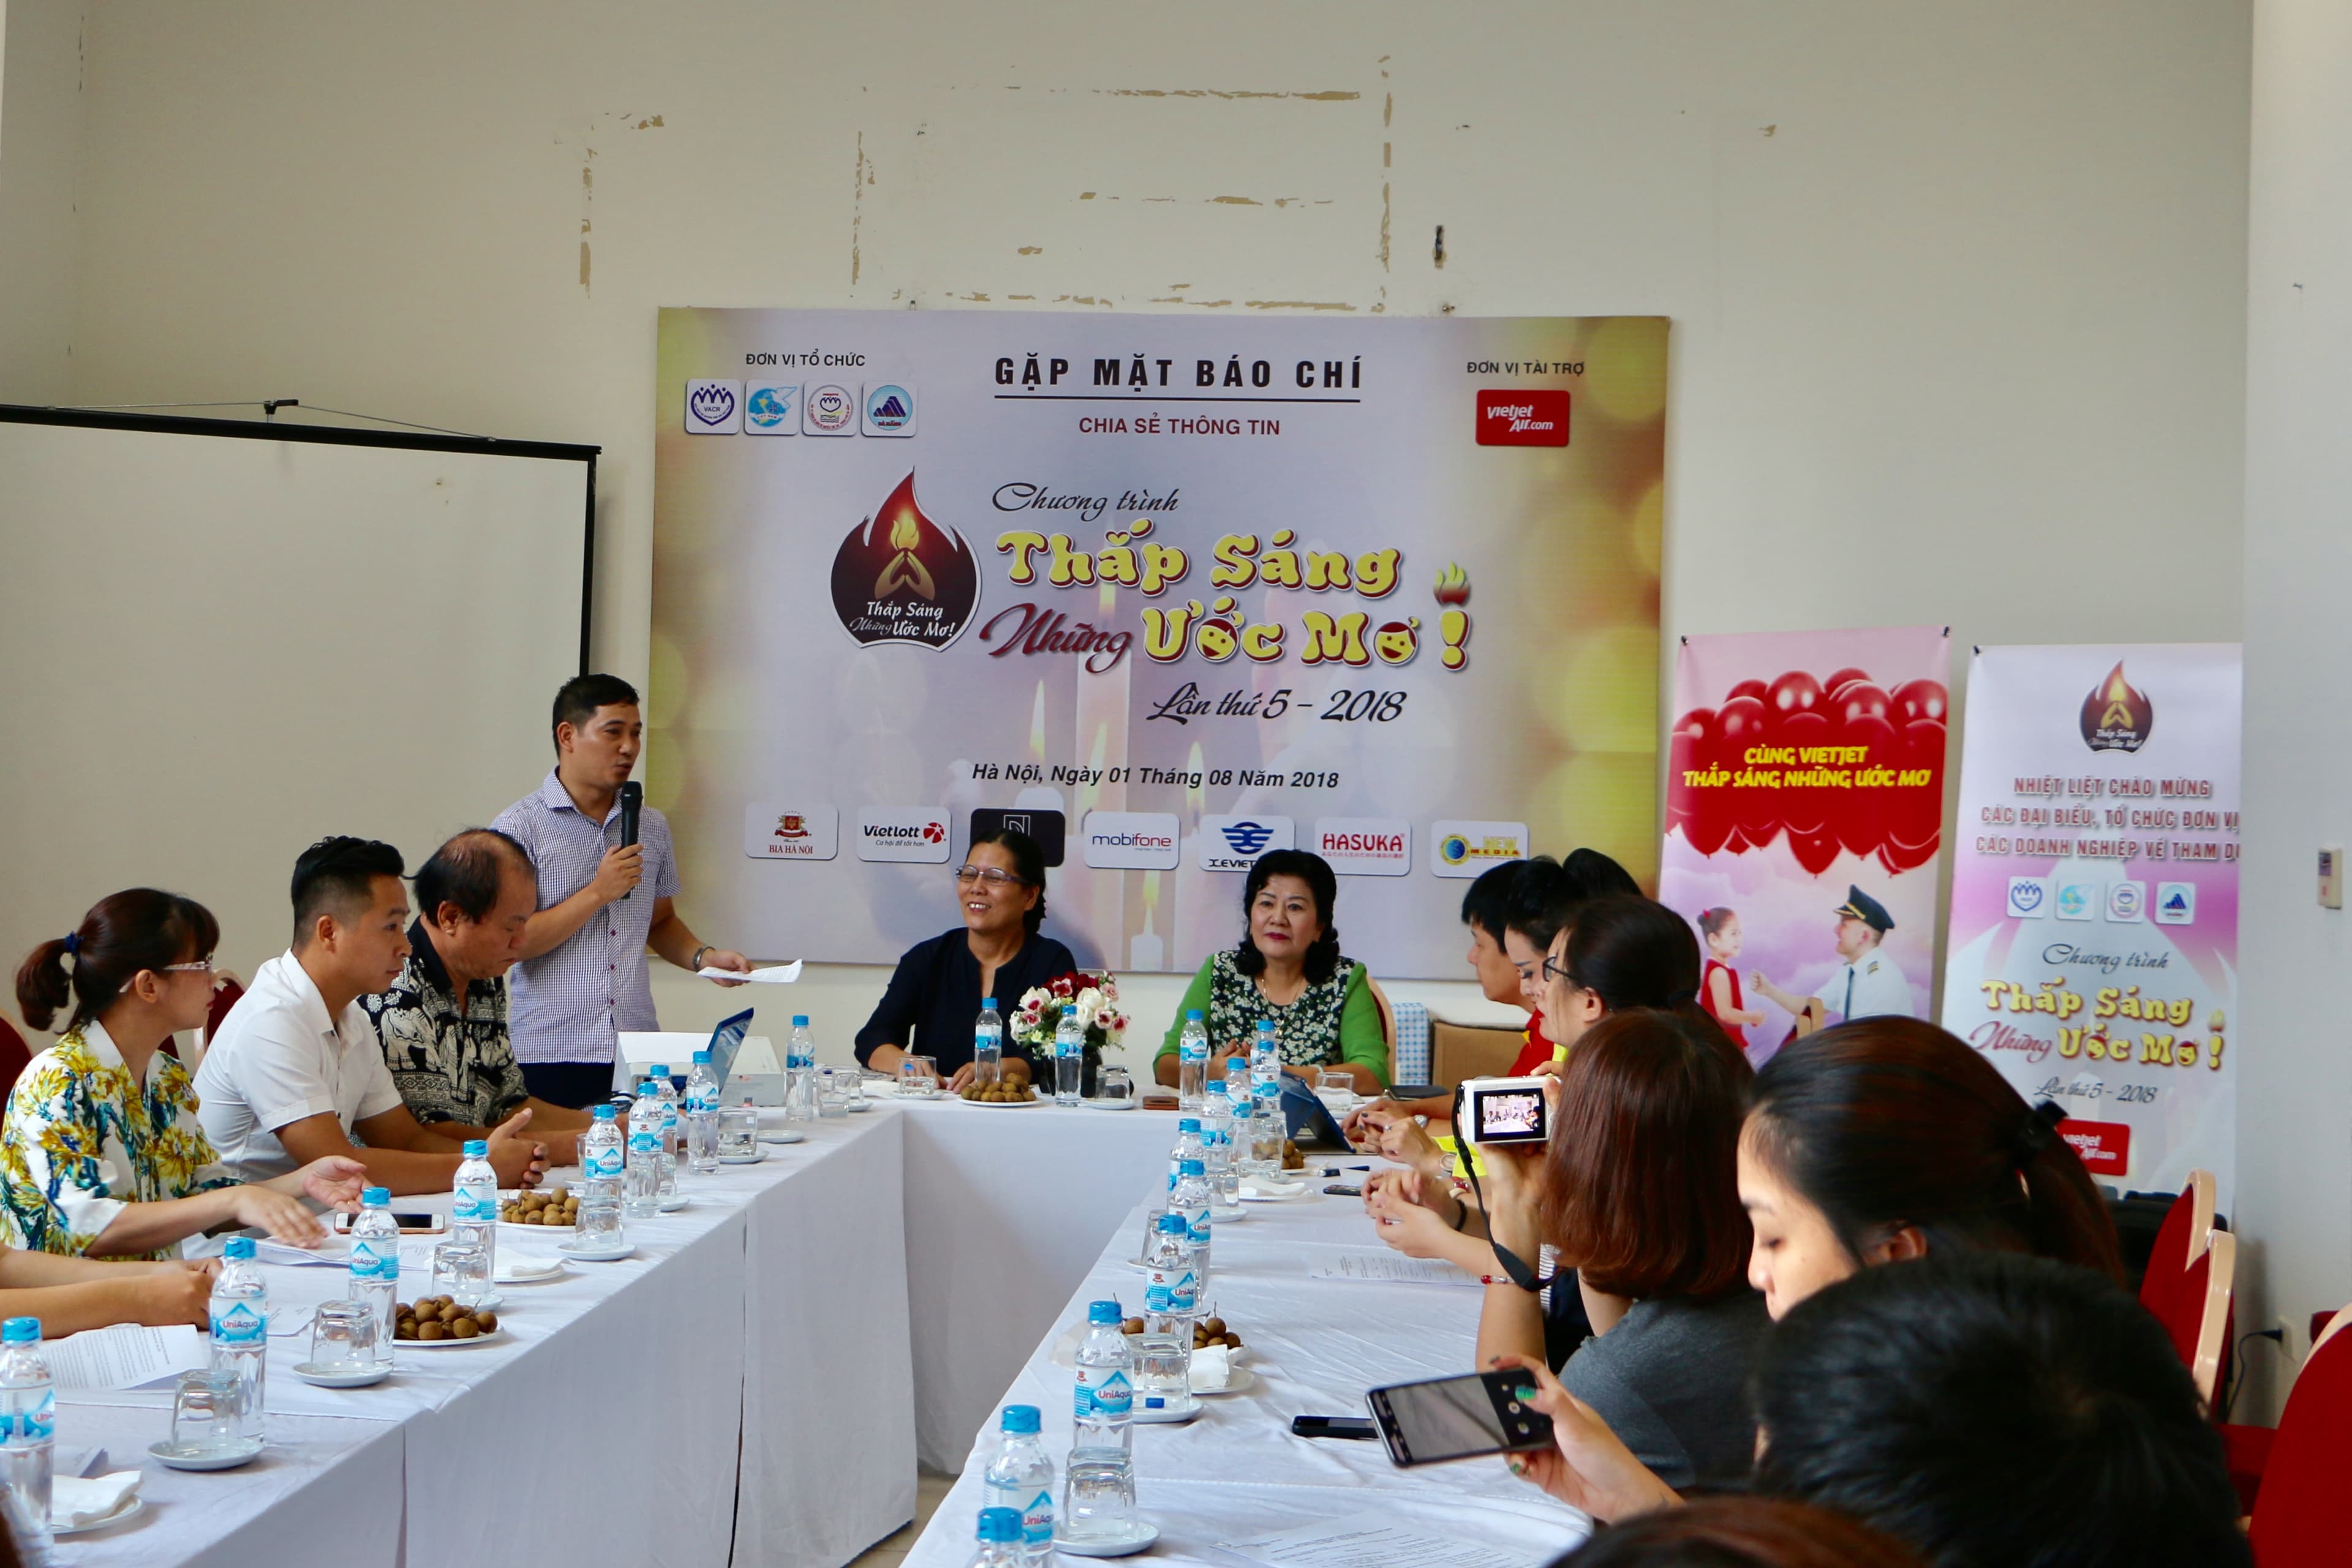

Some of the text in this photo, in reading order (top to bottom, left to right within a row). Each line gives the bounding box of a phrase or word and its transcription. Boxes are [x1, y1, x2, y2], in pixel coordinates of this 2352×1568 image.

[745, 349, 865, 368] ĐƠN VỊ TỔ CHỨC
[1467, 360, 1585, 377] ĐƠN VỊ TÀI TRỢ
[995, 352, 1362, 392] GẶP MẶT BÁO CHÍ
[1079, 412, 1280, 435] CHIA SẺ THÔNG TIN
[992, 482, 1180, 522] Chương trình
[996, 518, 1402, 599] Thắp Sáng
[867, 600, 943, 620] Thắp Sáng
[850, 617, 956, 637] Những Ước Mơ!
[979, 603, 1132, 674] Những
[1140, 595, 1286, 663] Ước
[1146, 682, 1213, 725] Lần
[1216, 689, 1261, 717] thứ
[1262, 690, 1291, 717] 5
[1320, 690, 1408, 722] 2018
[1744, 744, 1869, 766] CÙNG VIETJET
[971, 763, 1340, 788] Hà Nội, Ngày 01 Tháng 08 Năm 2018
[1682, 761, 1932, 788] THẮP SÁNG NHỮNG ƯỚC MƠ
[2014, 775, 2210, 799] NHIỆT LIỆT CHÀO MỪNG
[1981, 804, 2013, 823] CÁC
[2019, 807, 2048, 827] ĐẠI
[2132, 807, 2175, 827] CHỨC
[2183, 810, 2215, 827] ĐƠN
[864, 824, 920, 837] Vietlott
[1092, 832, 1172, 847] mobifone
[1323, 833, 1403, 851] HASUKA
[769, 844, 783, 853] BIA
[1976, 834, 2008, 853] CÁC
[2016, 837, 2070, 855] DOANH
[2077, 838, 2138, 861] NGHIỆP
[2172, 841, 2217, 859] THAM
[2042, 943, 2169, 974] Chương trình
[1980, 976, 2193, 1025] Thắp Sáng
[1968, 1020, 2053, 1063] Những
[2057, 1022, 2130, 1060] Ước
[2034, 1076, 2065, 1099] Lần
[2089, 1083, 2103, 1099] 5
[2117, 1084, 2158, 1104] 2018
[223, 1320, 258, 1330] UniAqua
